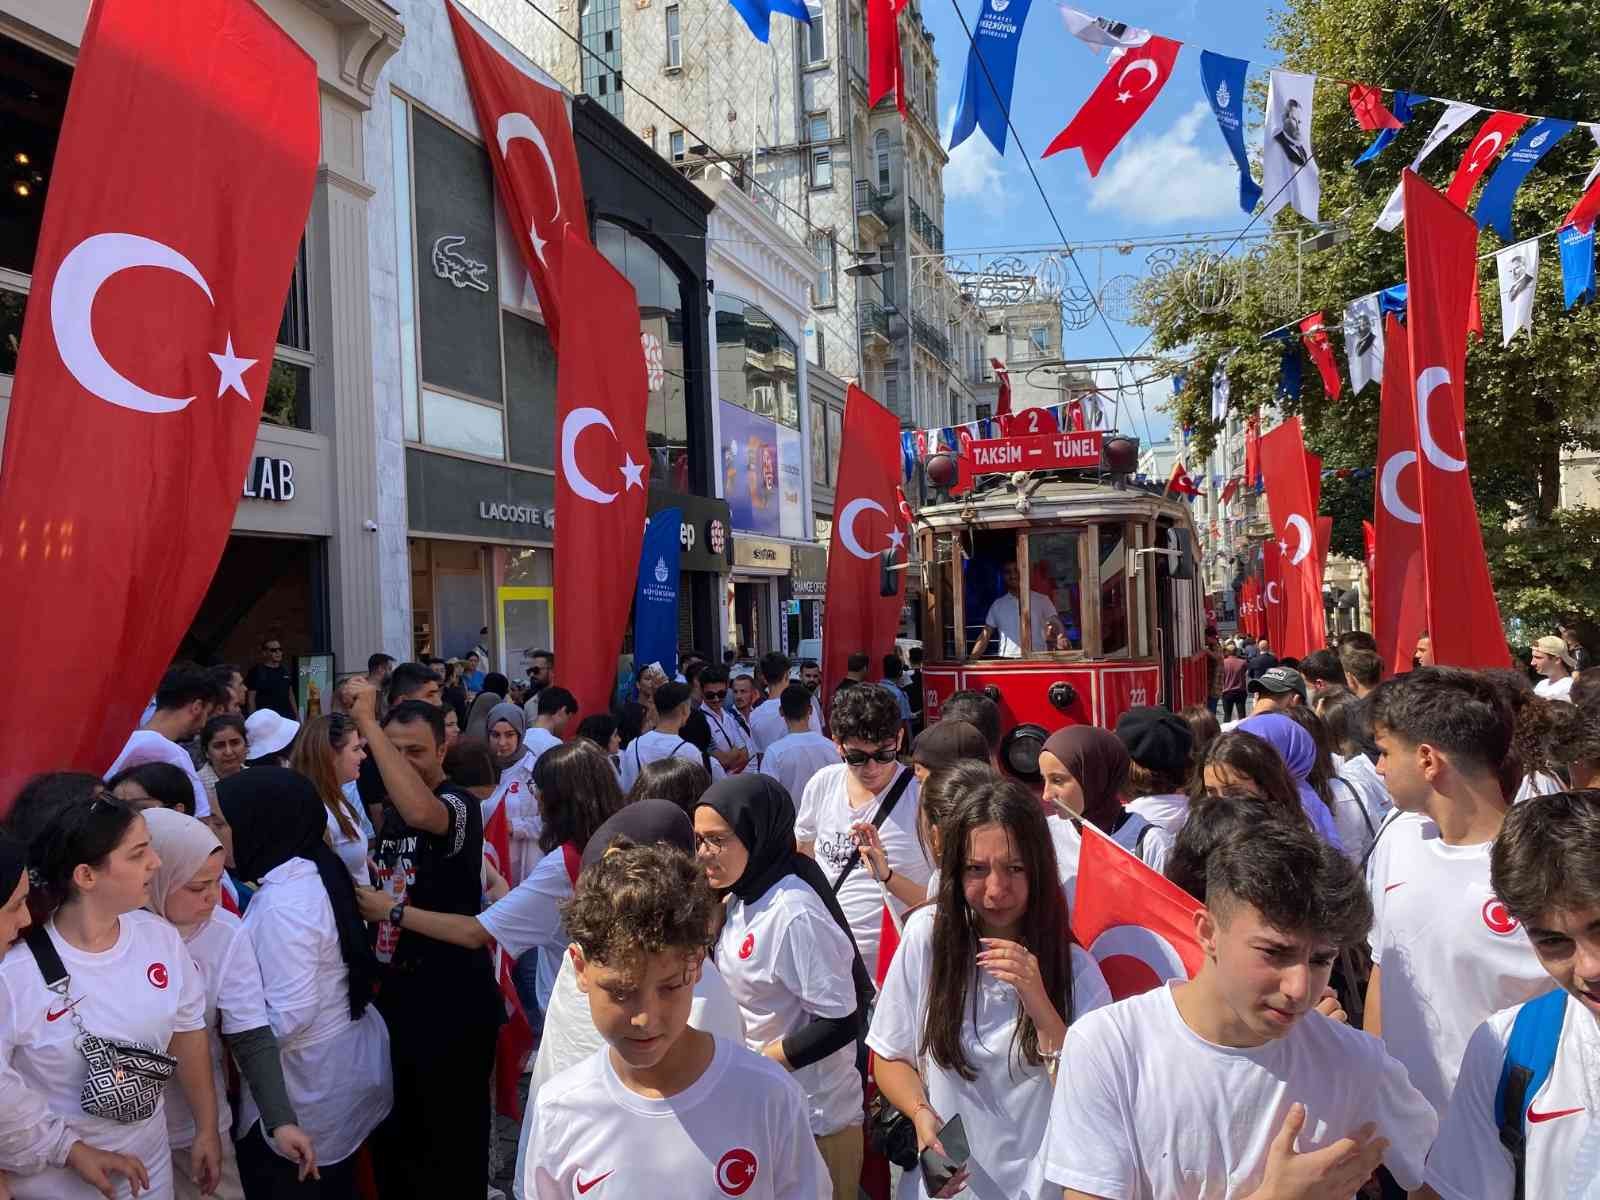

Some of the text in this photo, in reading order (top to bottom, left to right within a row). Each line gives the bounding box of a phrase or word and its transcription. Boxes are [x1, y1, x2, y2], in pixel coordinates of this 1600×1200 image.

[1028, 411, 1039, 432] 2
[973, 441, 1022, 465] TAKSİM
[1053, 436, 1099, 458] TÜNEL
[243, 457, 295, 500] LAB
[480, 501, 541, 525] LACOSTE
